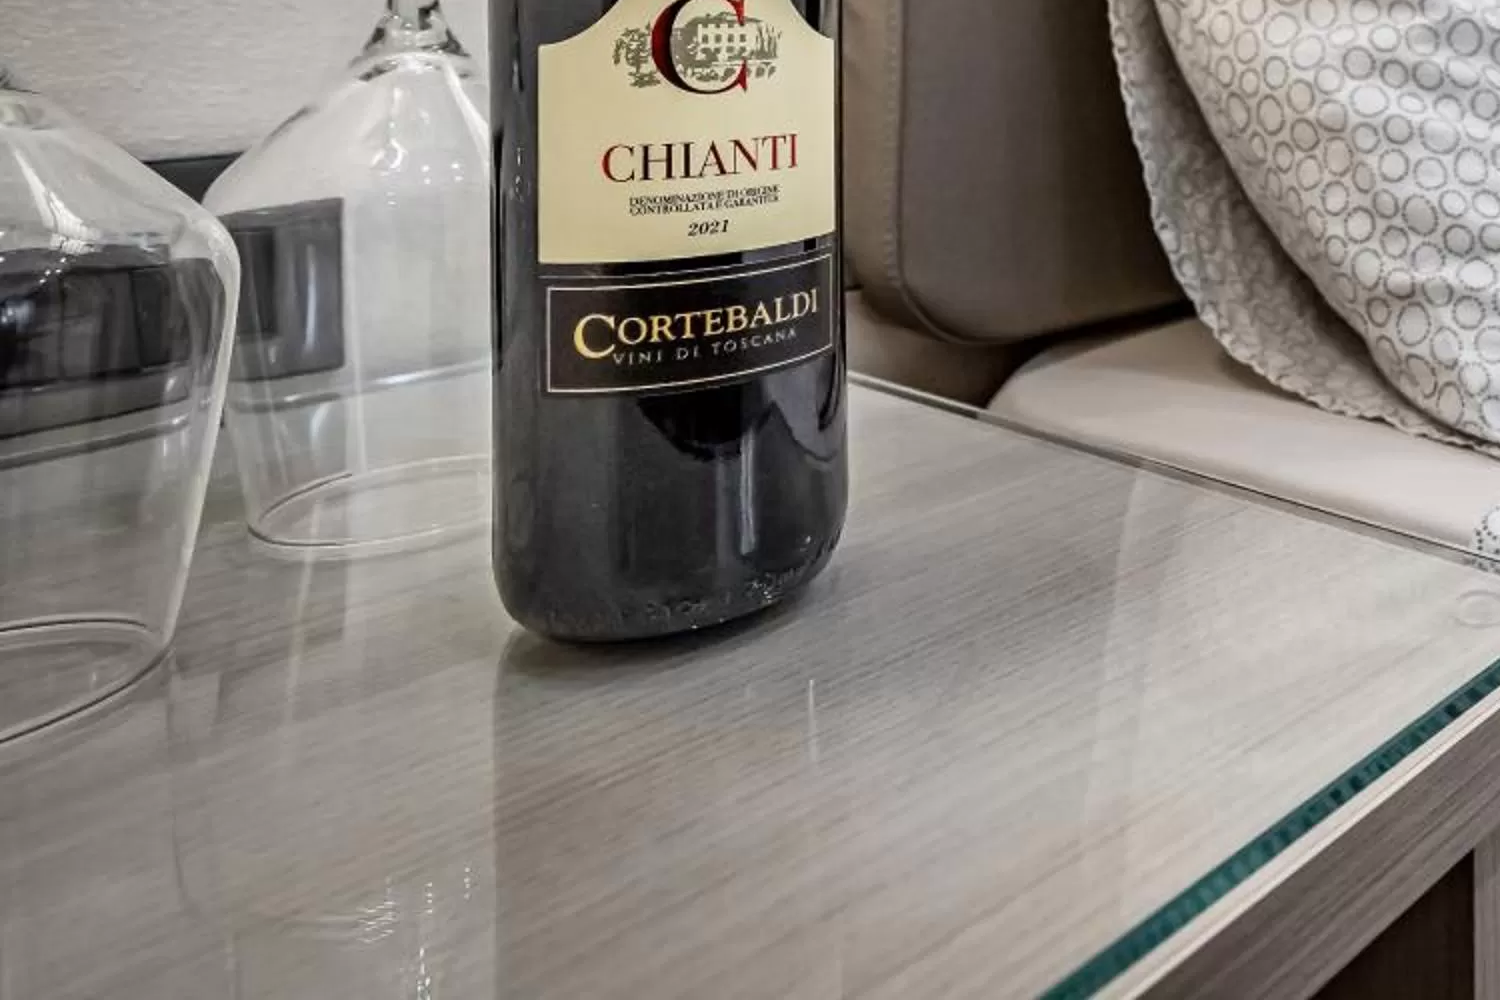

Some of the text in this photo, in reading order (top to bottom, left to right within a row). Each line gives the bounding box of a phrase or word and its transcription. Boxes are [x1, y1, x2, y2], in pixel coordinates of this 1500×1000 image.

[601, 133, 799, 183] CHIANTI
[687, 219, 729, 236] 2021
[573, 288, 818, 359] CORTEBALDI
[612, 327, 798, 366] VINI DI TOSCANA
